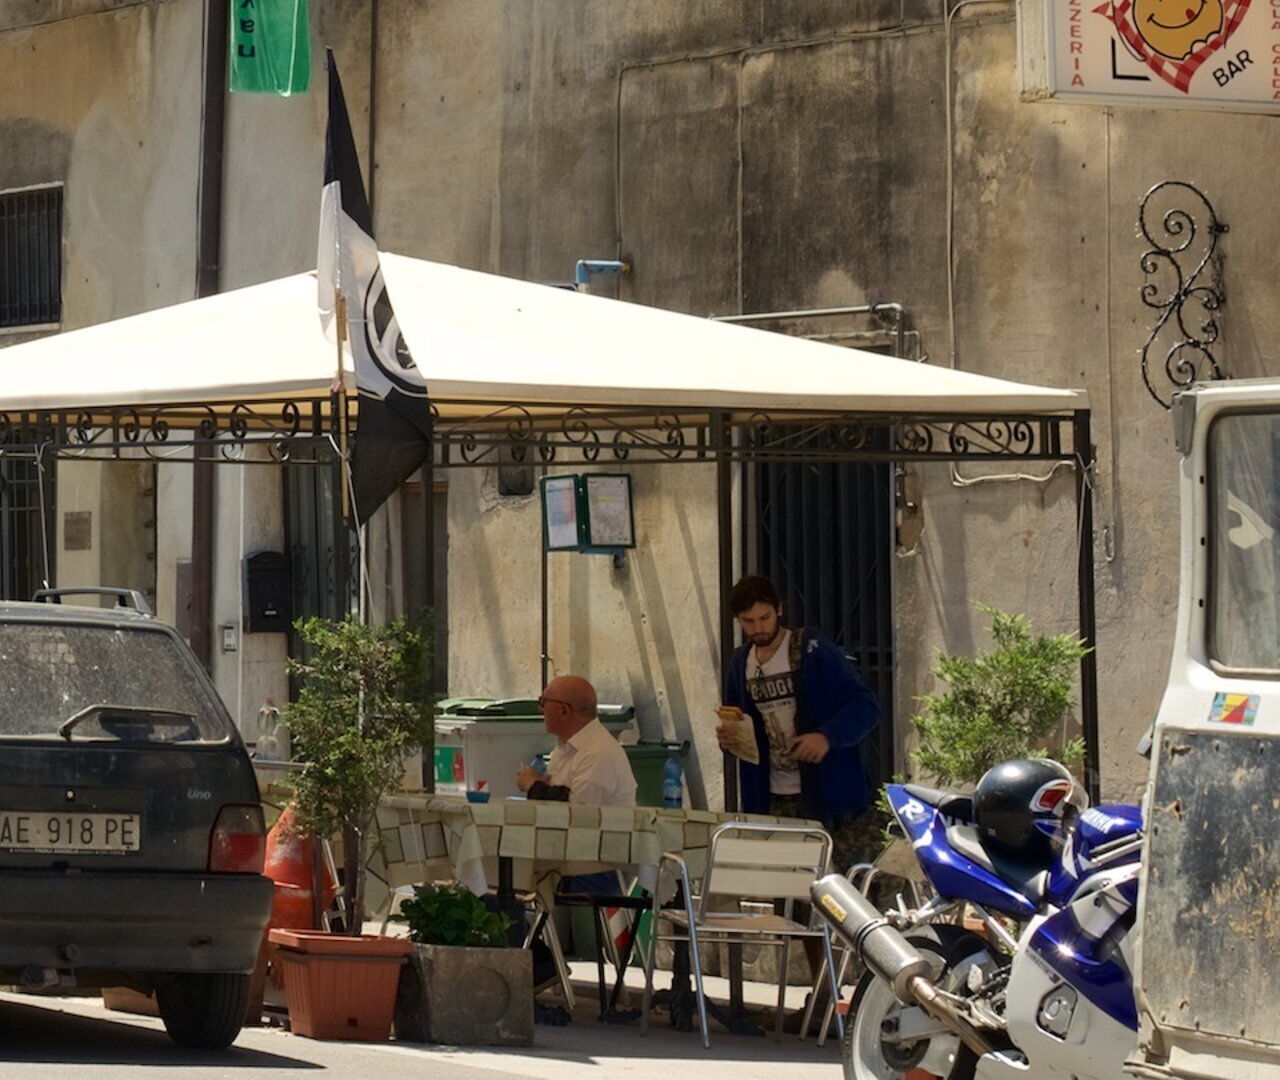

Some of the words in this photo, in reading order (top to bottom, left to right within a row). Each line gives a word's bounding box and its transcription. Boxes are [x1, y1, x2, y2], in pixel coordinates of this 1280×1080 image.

[1212, 48, 1255, 88] BAR
[187, 787, 211, 800] Uno
[0, 816, 30, 844] AE
[46, 817, 94, 845] 918
[104, 818, 134, 846] PE
